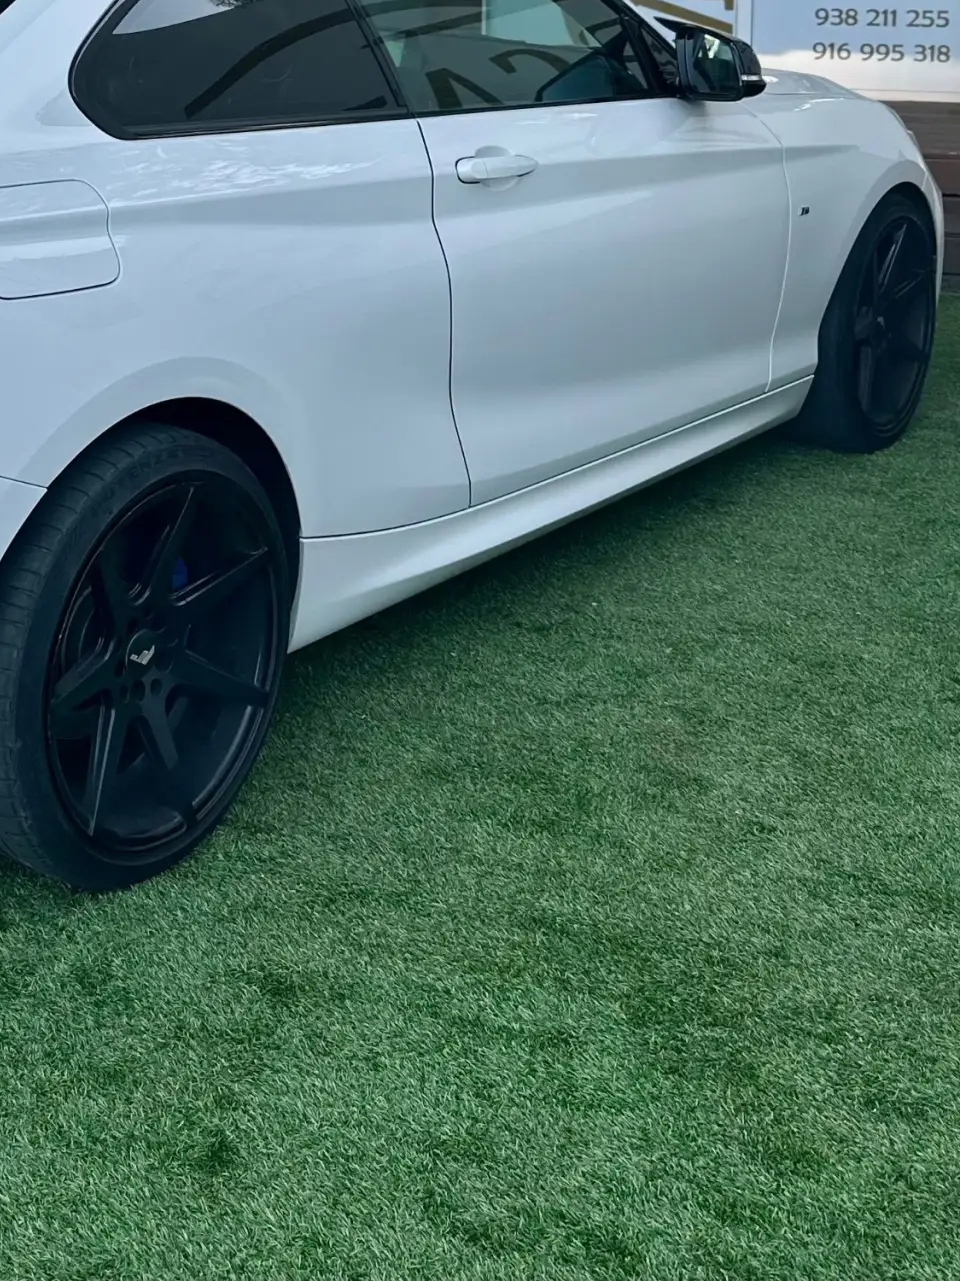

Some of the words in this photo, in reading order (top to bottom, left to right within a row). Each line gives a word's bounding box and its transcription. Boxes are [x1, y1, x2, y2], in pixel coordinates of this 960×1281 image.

[815, 8, 858, 26] 938
[866, 9, 897, 27] 211
[906, 10, 950, 28] 255
[813, 42, 851, 60] 916
[860, 43, 905, 61] 995
[913, 44, 950, 63] 318
